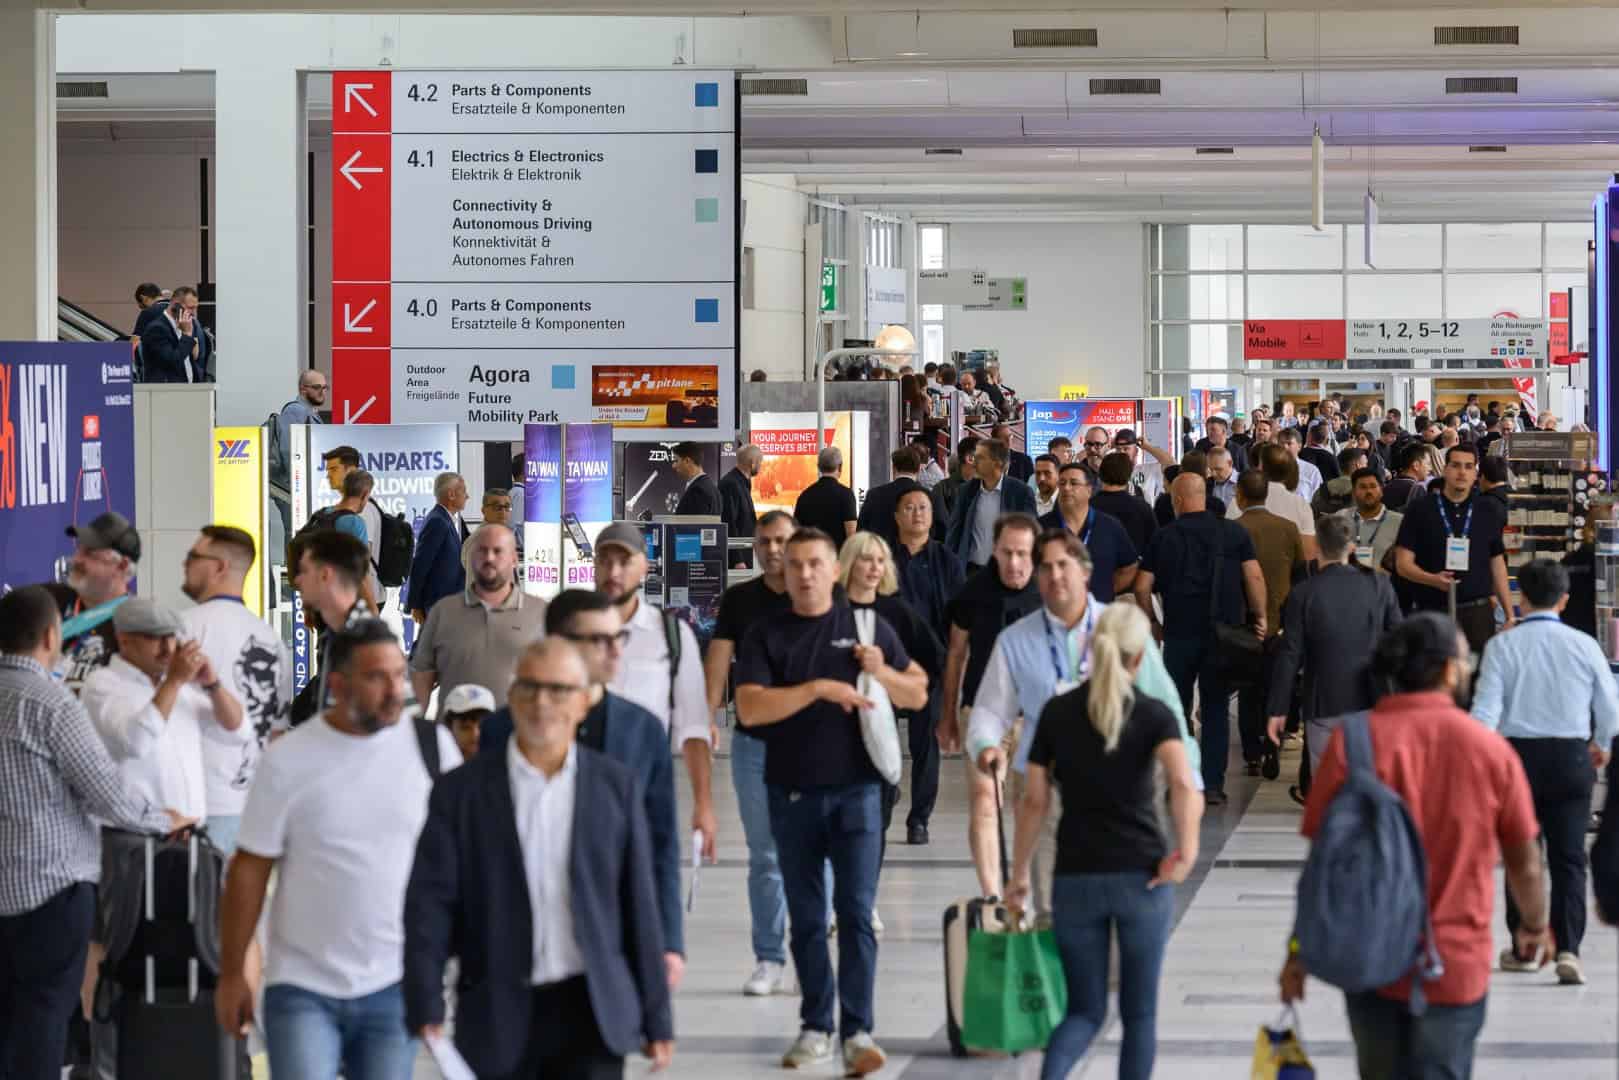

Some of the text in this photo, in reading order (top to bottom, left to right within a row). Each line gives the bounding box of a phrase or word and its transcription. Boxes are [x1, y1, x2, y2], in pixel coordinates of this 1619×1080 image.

[407, 83, 438, 102] 4.2
[452, 83, 592, 99] Parts & Components
[452, 102, 625, 117] Ersatzteile & Komponenten
[407, 149, 435, 168] 4.1
[451, 149, 604, 163] Electrics & Electronics
[451, 167, 582, 181] Elektrik & Elektronik
[452, 198, 553, 214] Connectivity &
[452, 217, 592, 233] Autonomous Driving
[453, 234, 551, 249] Konnektivität &
[452, 253, 574, 267] Autonomes Fahren
[406, 298, 438, 317] 4.0
[451, 298, 592, 315] Parts & Components
[451, 316, 625, 333] Ersatzteile & Komponenten
[1248, 323, 1265, 334] Via
[1378, 322, 1391, 340] 1,
[1397, 322, 1413, 340] 2,
[1248, 337, 1287, 348] Mobile
[406, 364, 446, 375] Outdoor
[468, 364, 531, 387] Agora
[406, 377, 430, 388] Area
[406, 389, 460, 403] Freigelände
[468, 391, 512, 405] Future
[468, 409, 559, 425] Mobility Park
[19, 364, 67, 507] NEW
[753, 432, 816, 442] YOUR JOURNEY
[527, 461, 558, 477] TAIWAN
[567, 461, 608, 477] TAIWAN
[296, 627, 305, 657] 4.0
